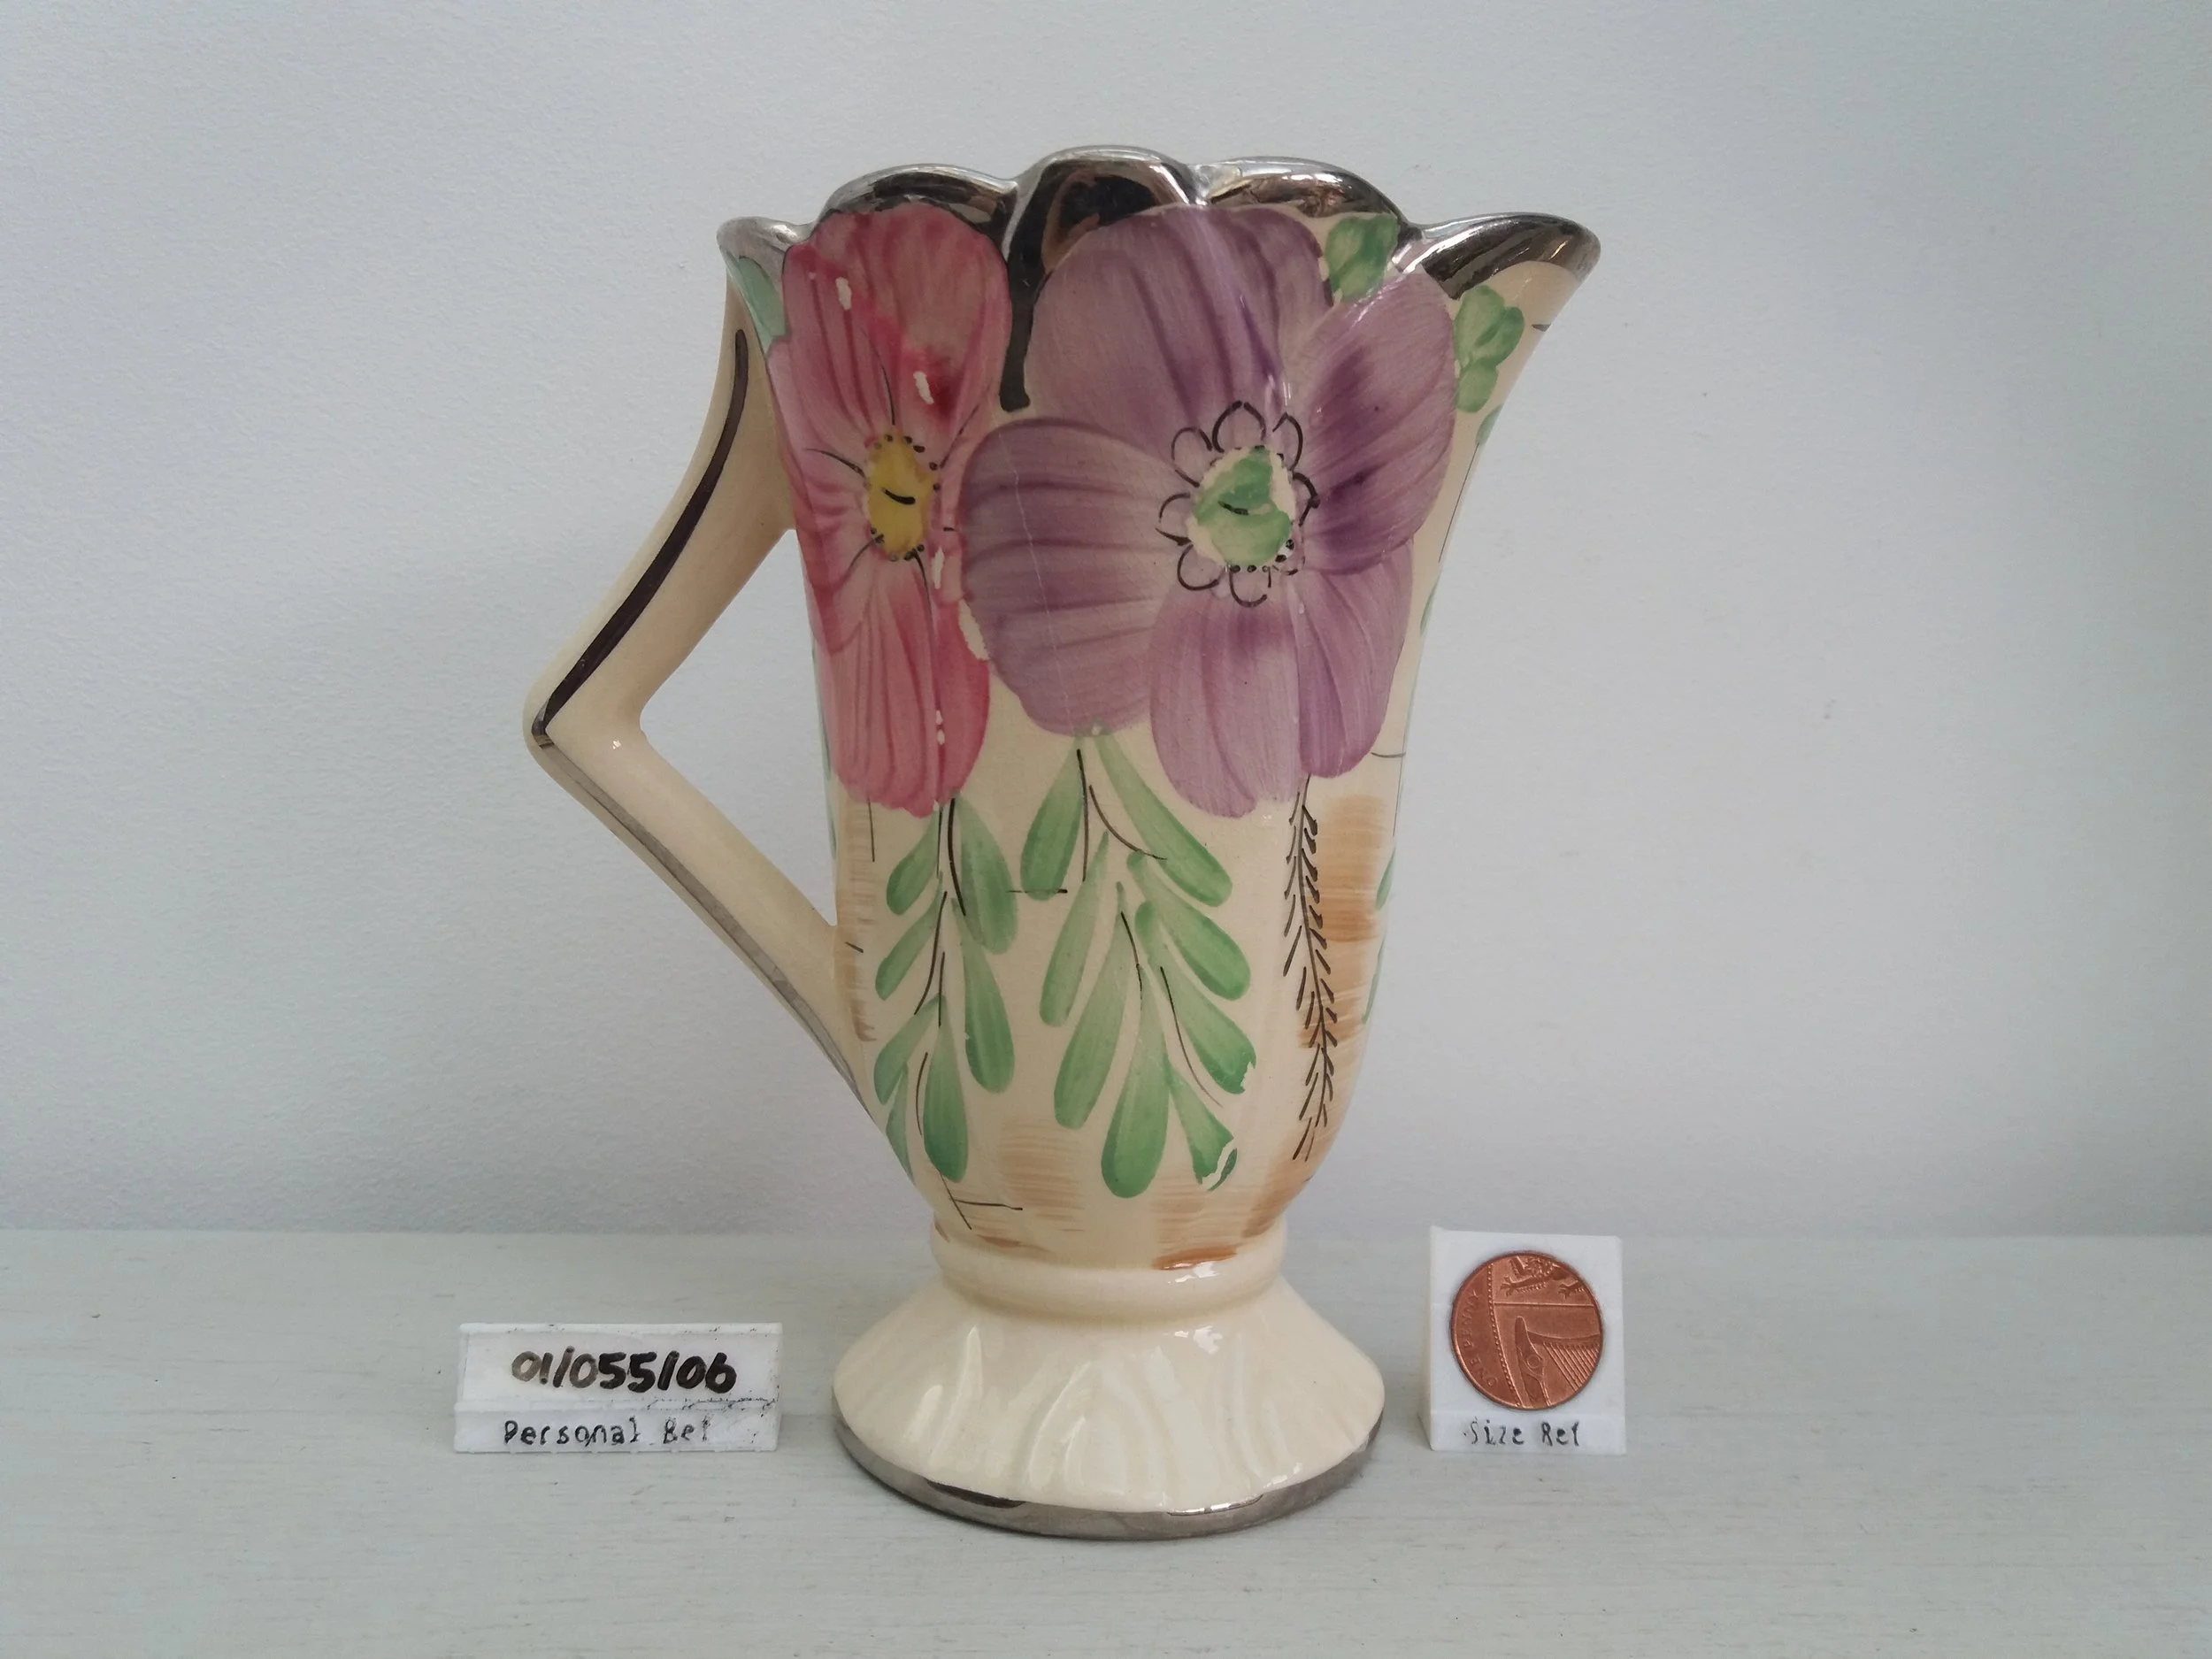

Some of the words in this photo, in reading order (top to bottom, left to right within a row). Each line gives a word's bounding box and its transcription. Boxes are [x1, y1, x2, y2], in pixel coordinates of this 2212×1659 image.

[511, 1345, 737, 1394] 01/055/06
[503, 1416, 641, 1447] Personal
[1470, 1417, 1525, 1445] Size
